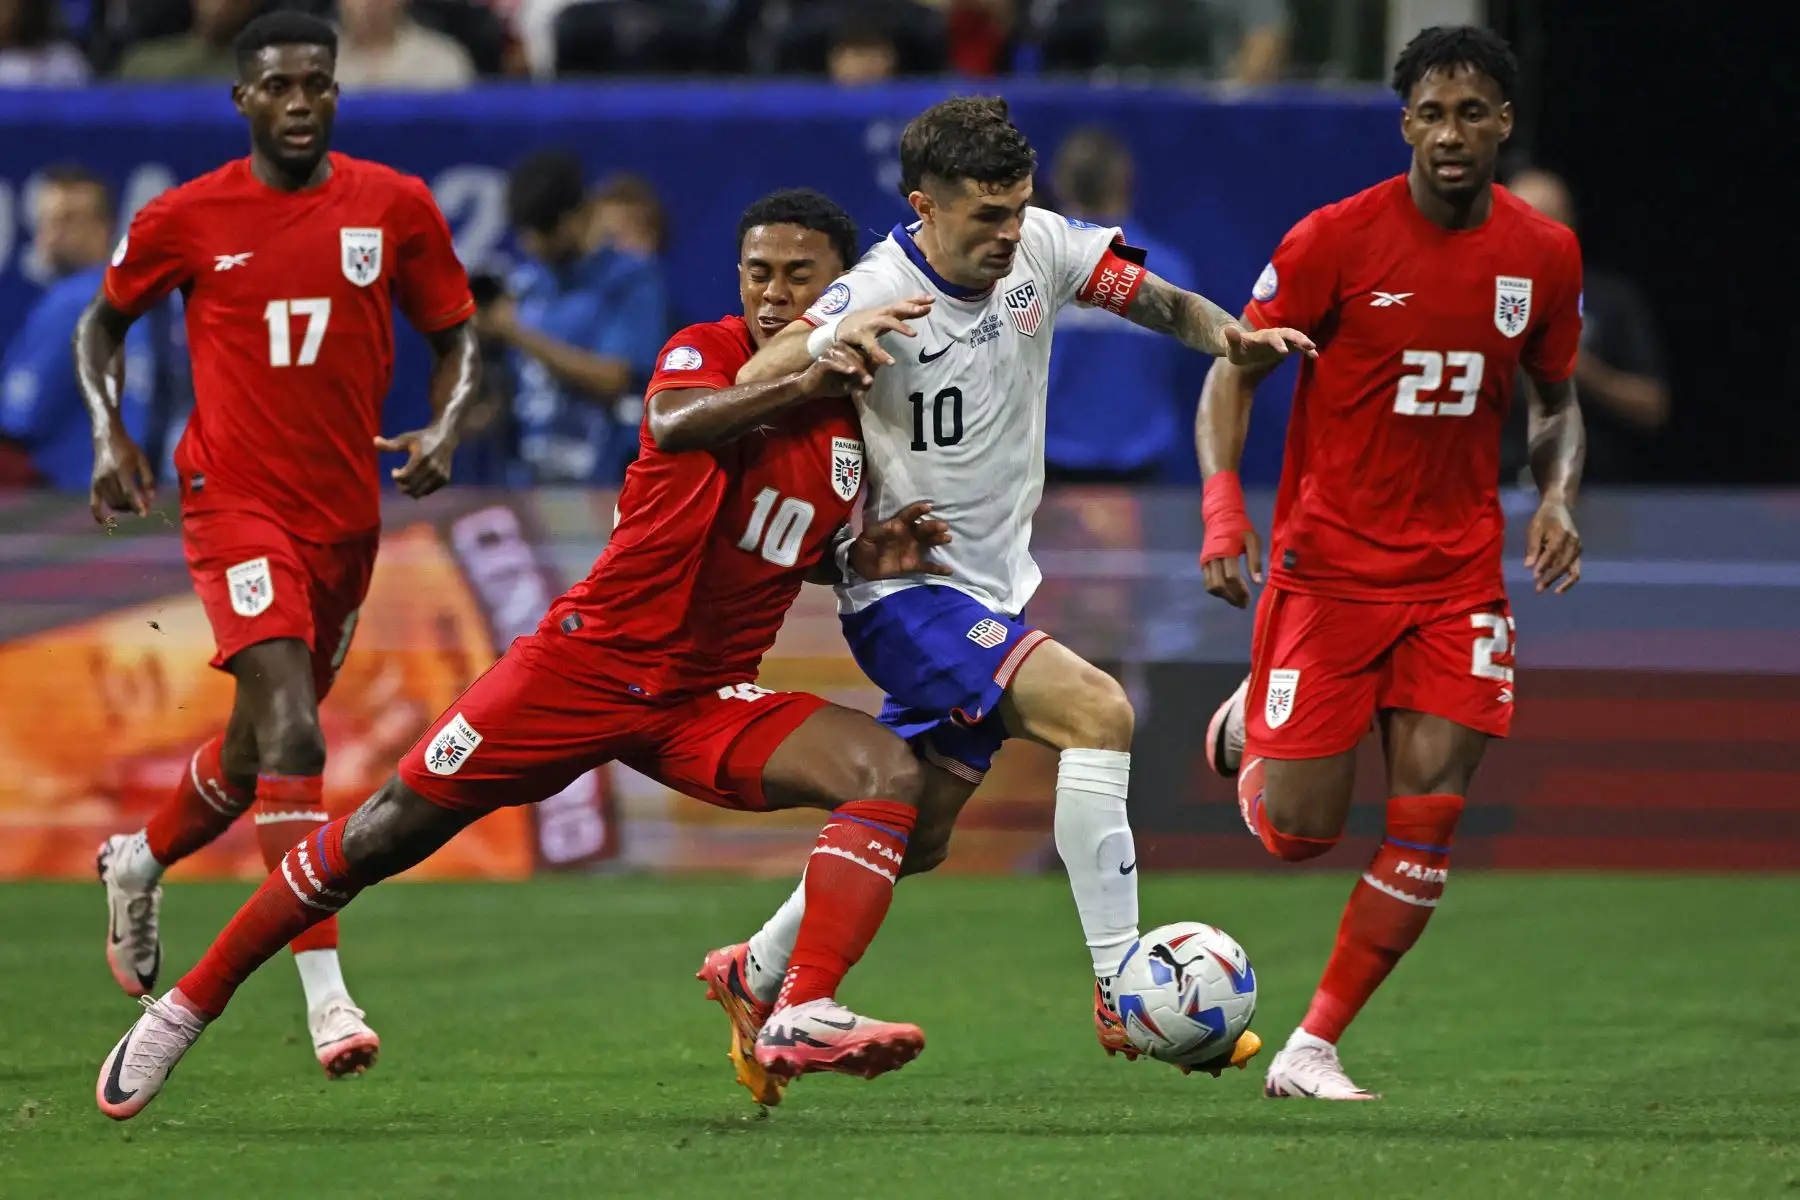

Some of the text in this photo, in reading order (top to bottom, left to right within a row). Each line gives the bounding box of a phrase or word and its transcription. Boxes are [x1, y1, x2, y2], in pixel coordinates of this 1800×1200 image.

[1005, 284, 1035, 309] USA
[1090, 267, 1118, 306] HOOSE
[263, 297, 331, 368] 17
[1393, 350, 1485, 417] 23
[908, 386, 964, 452] 10
[738, 486, 816, 568] 10
[969, 619, 994, 639] USA
